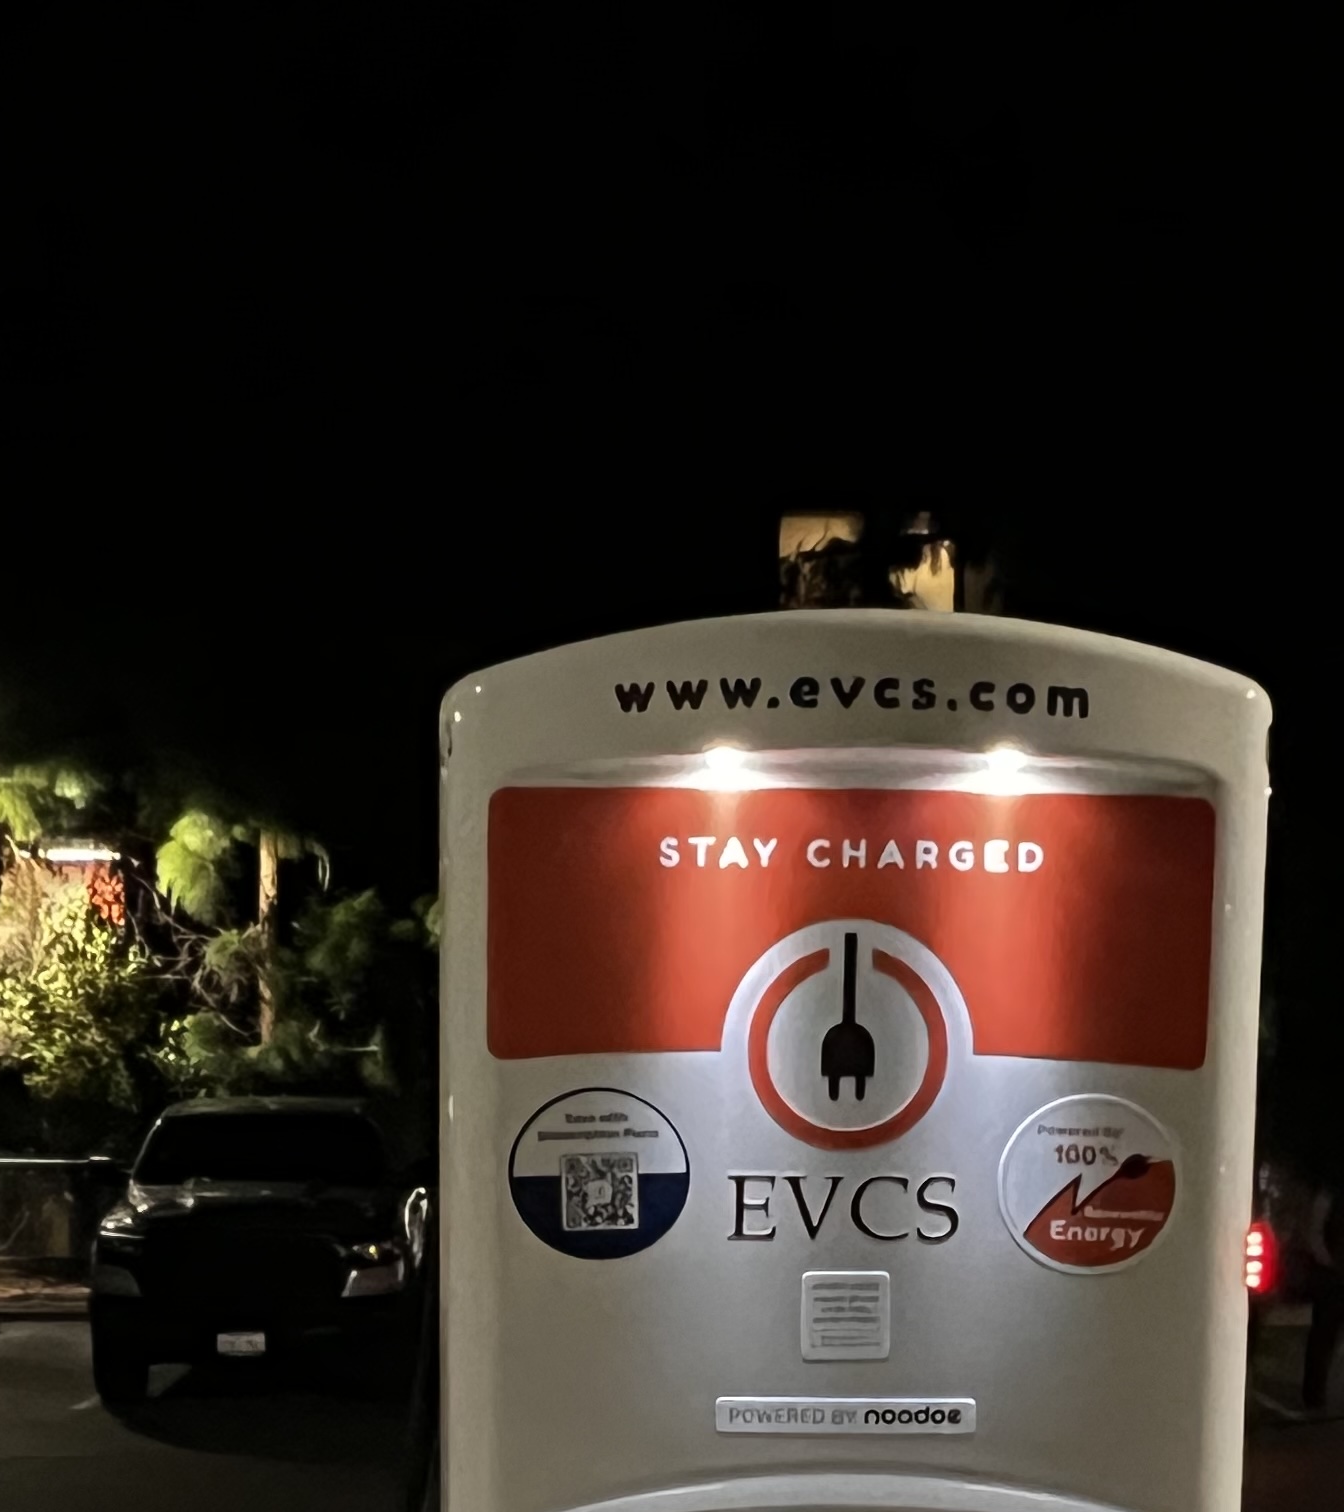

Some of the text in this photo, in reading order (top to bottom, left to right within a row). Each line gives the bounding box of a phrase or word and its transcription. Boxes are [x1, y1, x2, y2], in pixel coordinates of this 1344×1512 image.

[614, 675, 1090, 719] www.evcs.com
[658, 835, 1044, 873] STAY CHARGED
[1054, 1144, 1119, 1168] 100%
[727, 1174, 960, 1243] EVCS
[729, 1406, 962, 1425] POWERED BY noodoe
